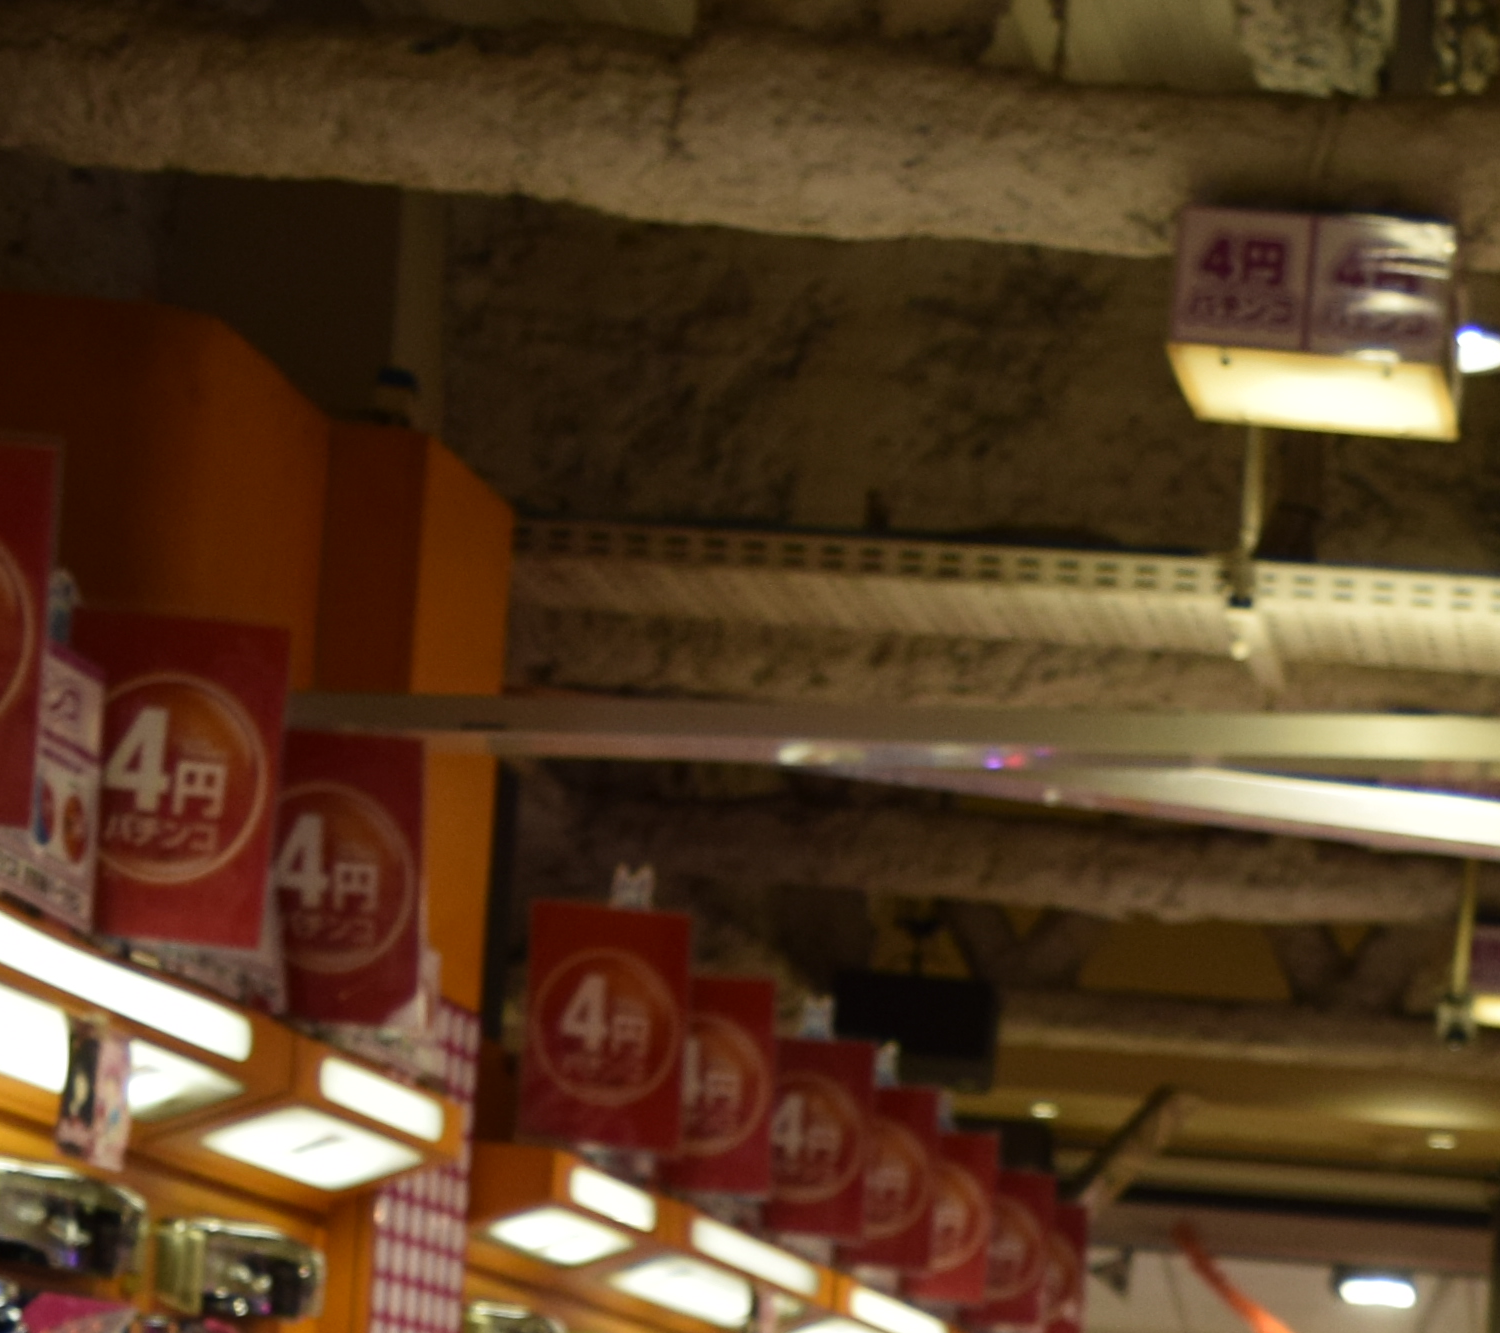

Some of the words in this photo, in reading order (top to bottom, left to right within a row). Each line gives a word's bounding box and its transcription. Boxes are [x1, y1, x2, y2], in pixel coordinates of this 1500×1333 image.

[1201, 238, 1286, 287] 4円
[103, 707, 228, 819] 4円
[105, 814, 218, 854] パチンコ
[274, 811, 379, 911] 4円
[559, 973, 652, 1056] 4円
